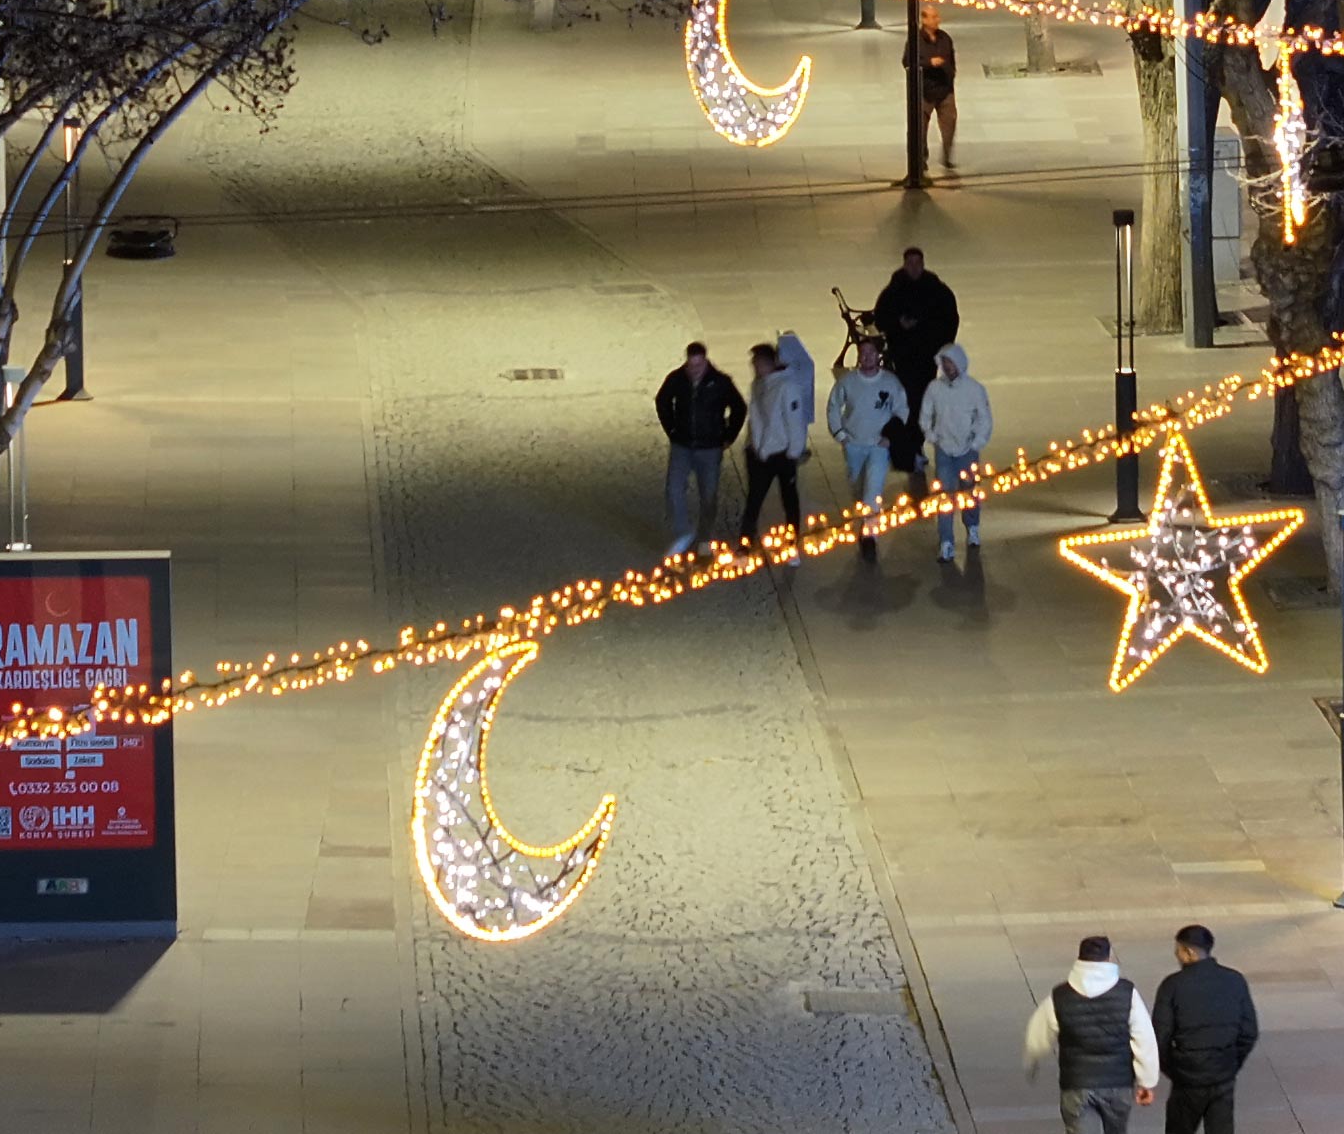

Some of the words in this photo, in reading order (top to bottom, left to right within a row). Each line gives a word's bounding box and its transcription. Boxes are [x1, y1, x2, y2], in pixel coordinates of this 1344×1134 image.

[18, 782, 50, 794] 0332
[53, 781, 76, 794] 353
[80, 781, 97, 793] 00
[101, 781, 119, 793] 08
